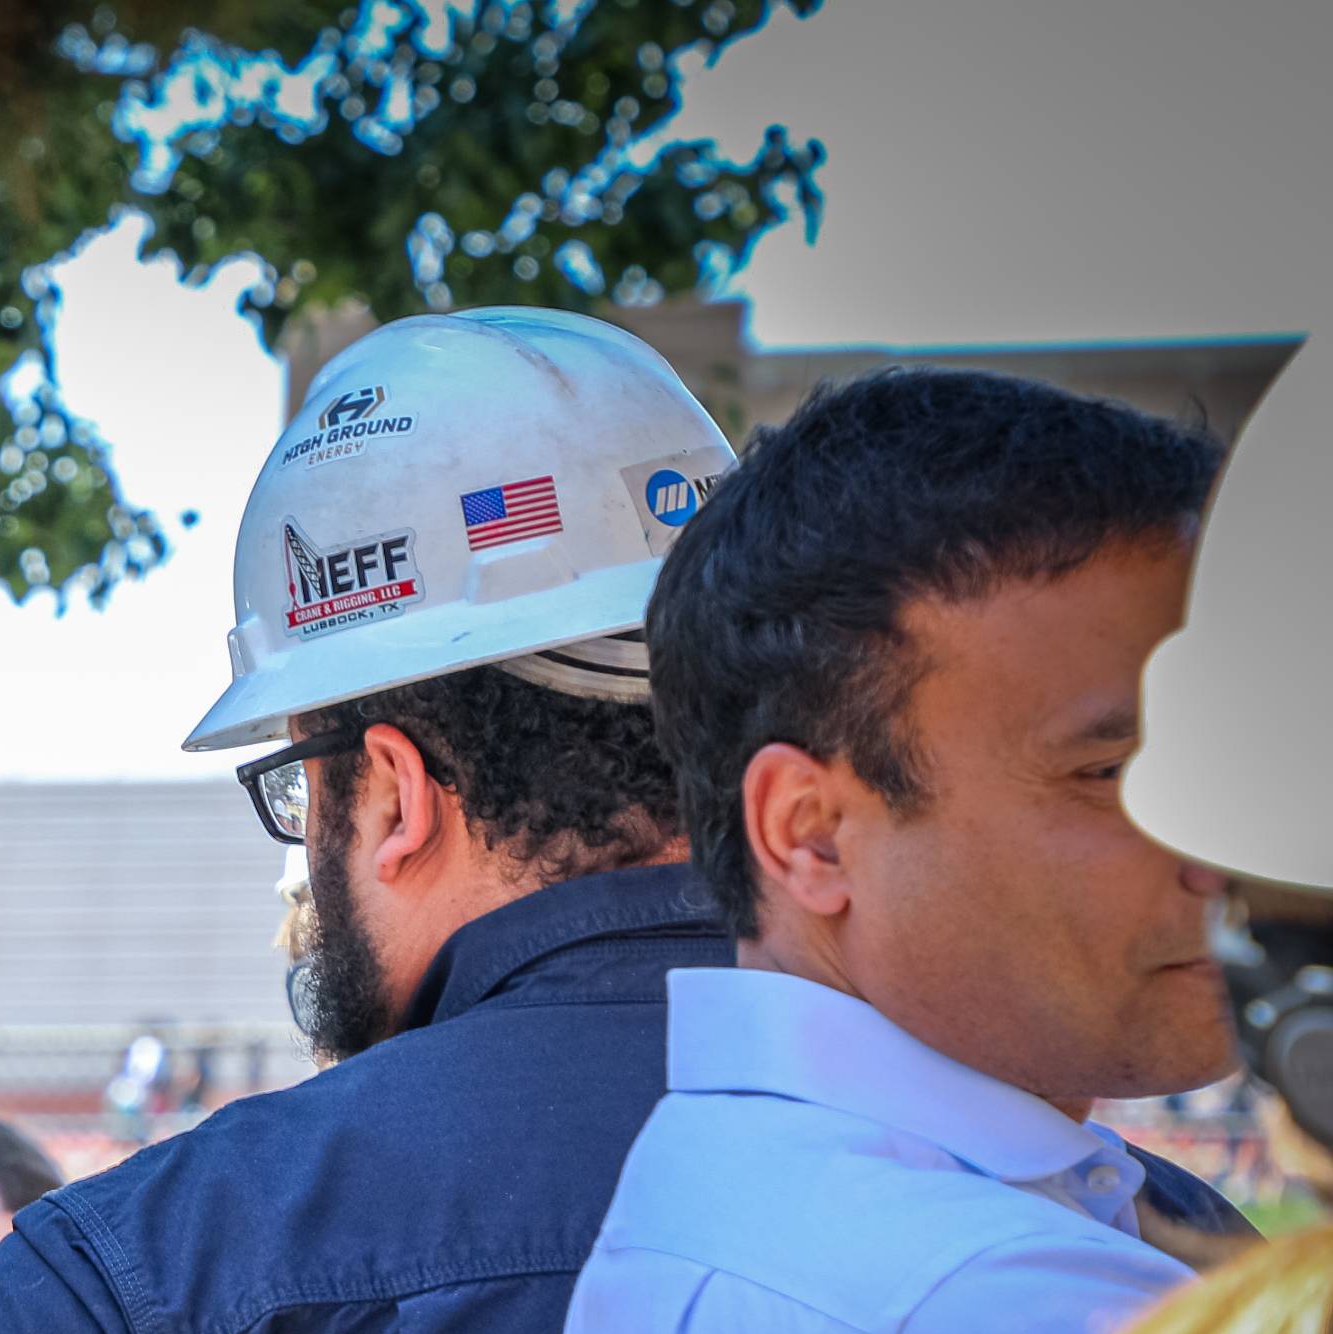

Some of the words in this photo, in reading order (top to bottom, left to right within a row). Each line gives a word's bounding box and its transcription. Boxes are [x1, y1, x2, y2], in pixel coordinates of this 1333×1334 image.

[283, 433, 324, 465] HIGH
[326, 416, 413, 444] GROUND
[308, 440, 365, 465] ENERGY
[297, 534, 409, 604] NEFF
[295, 606, 323, 623] CRANE
[324, 603, 331, 615] &
[380, 585, 402, 600] LLC
[303, 610, 374, 634] LUBBOCK,
[377, 602, 400, 614] TX
